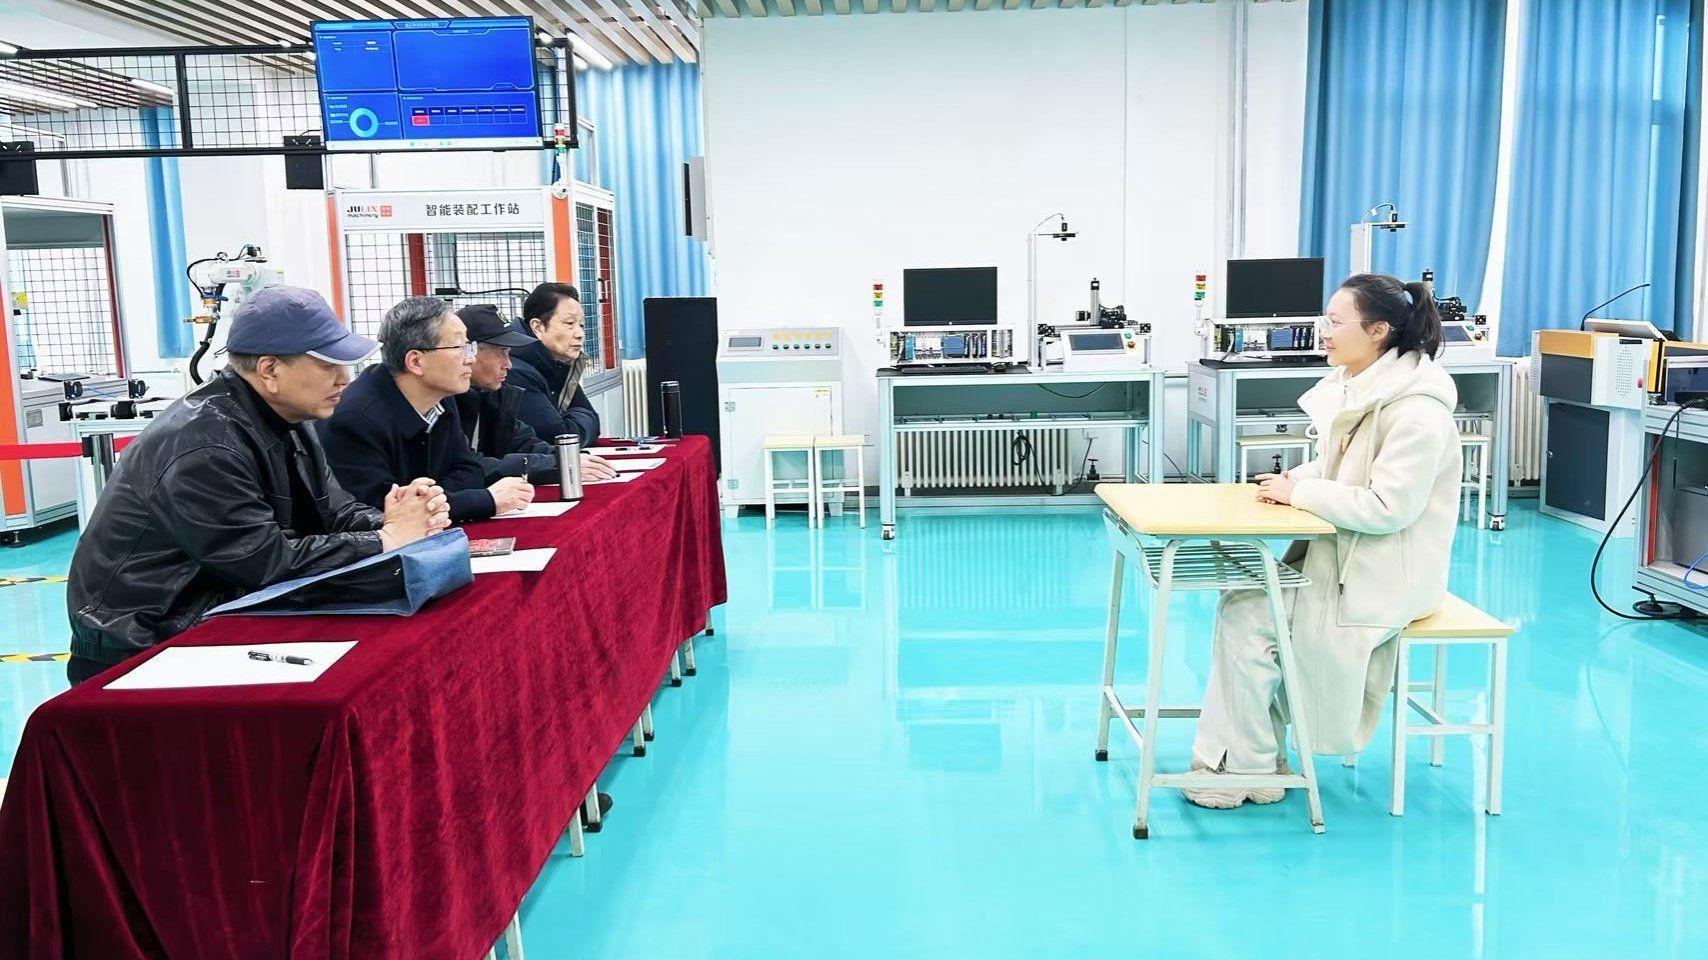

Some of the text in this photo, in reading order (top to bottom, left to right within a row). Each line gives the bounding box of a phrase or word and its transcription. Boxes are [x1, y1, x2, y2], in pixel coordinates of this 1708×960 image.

[425, 203, 520, 217] 智能装配工作站
